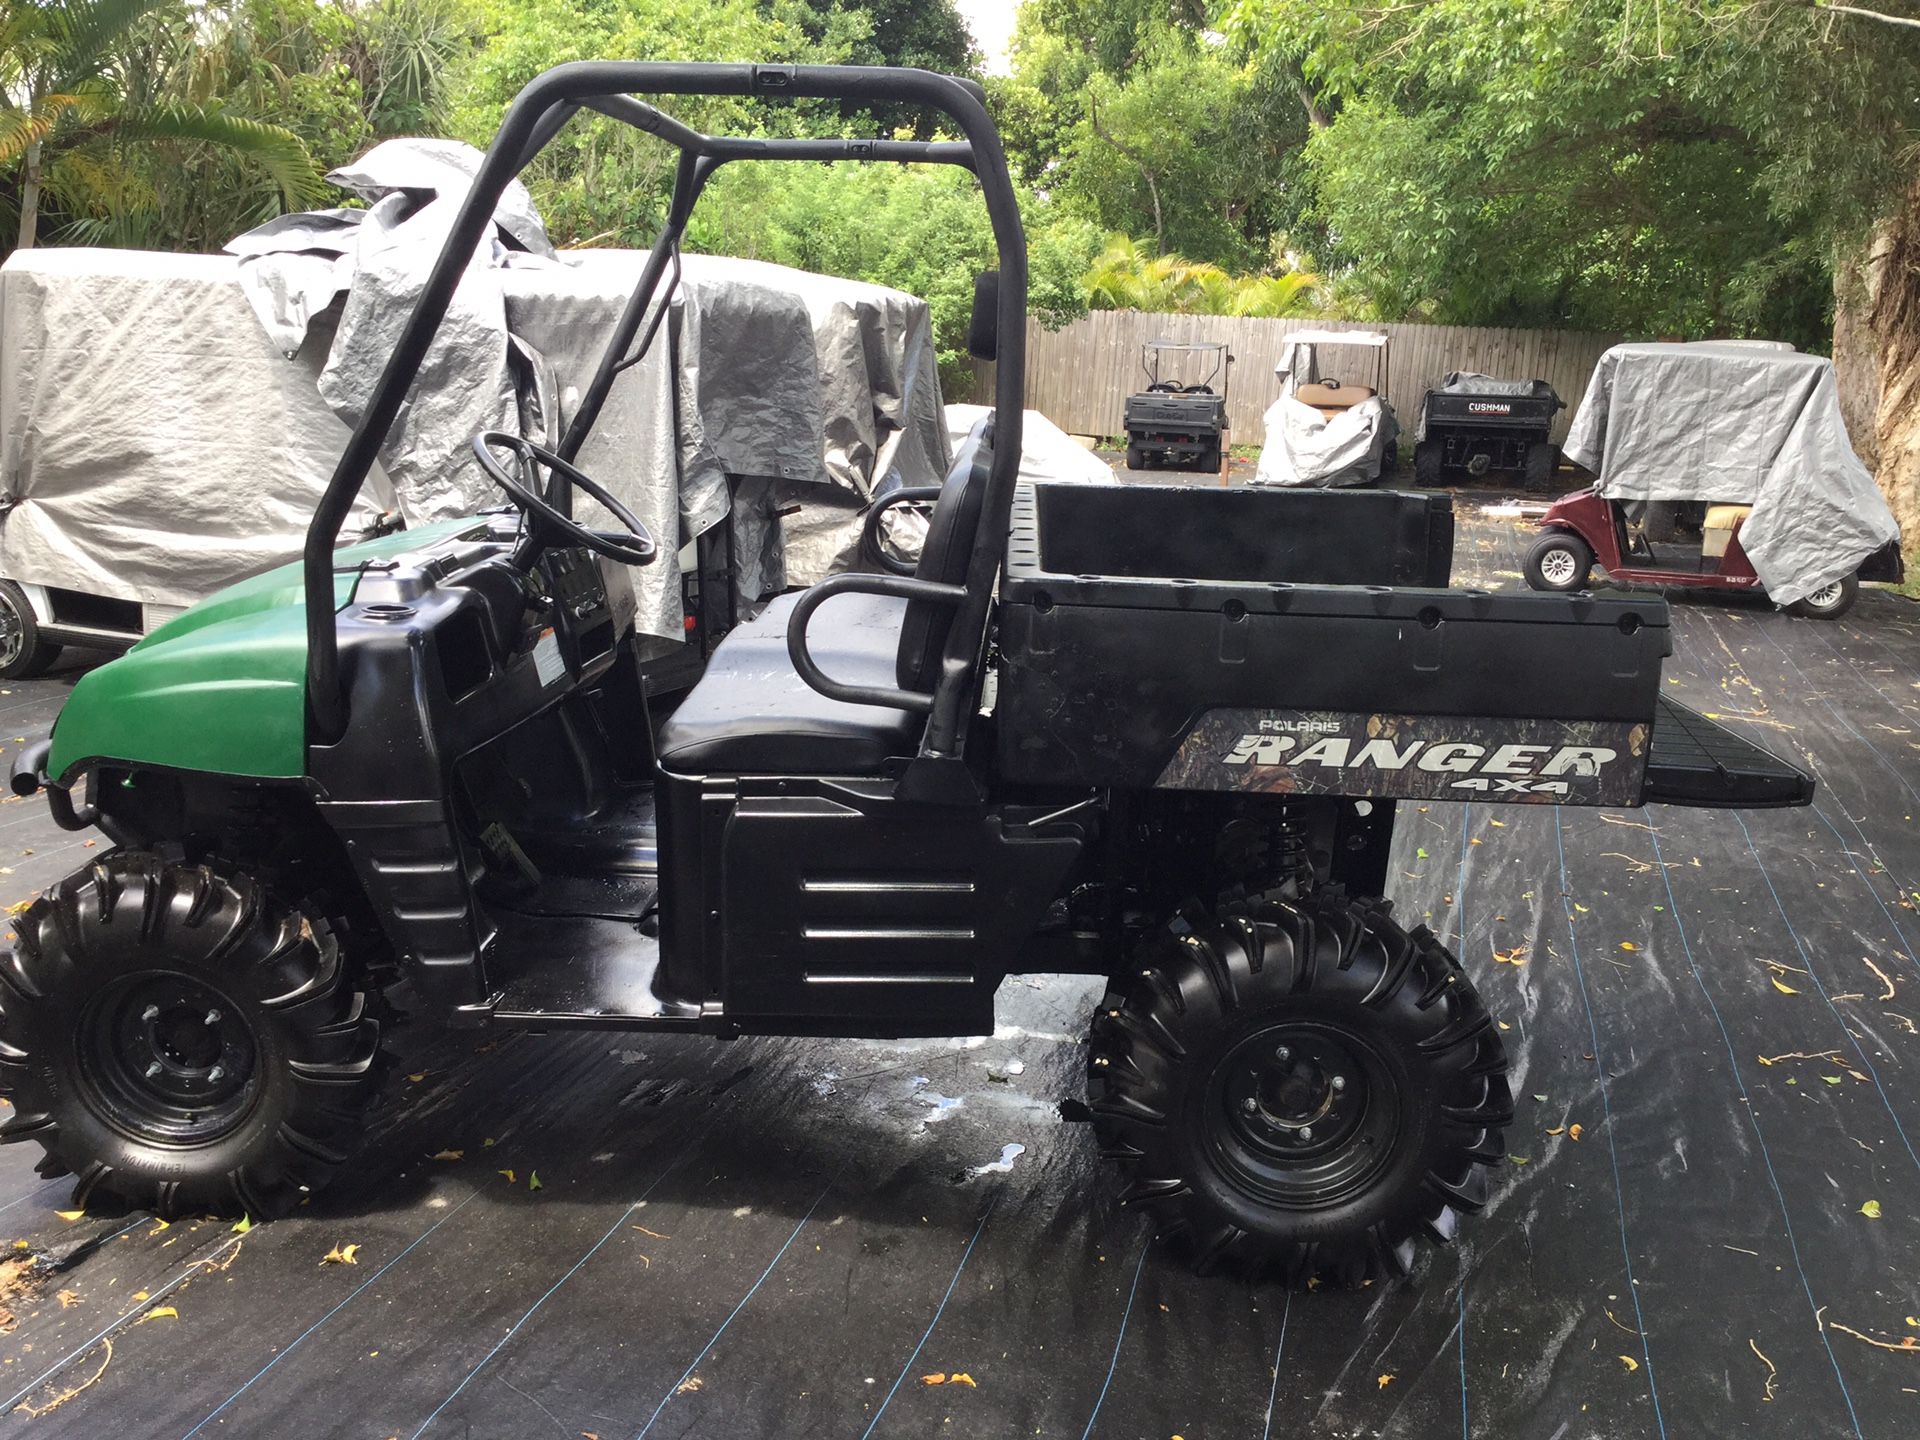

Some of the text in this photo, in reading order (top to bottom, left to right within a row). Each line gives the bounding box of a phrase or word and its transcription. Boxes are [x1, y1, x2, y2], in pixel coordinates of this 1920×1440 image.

[1468, 402, 1511, 412] CUSHMAN
[1258, 719, 1341, 733] POLARIS
[1222, 734, 1618, 777] RANGER
